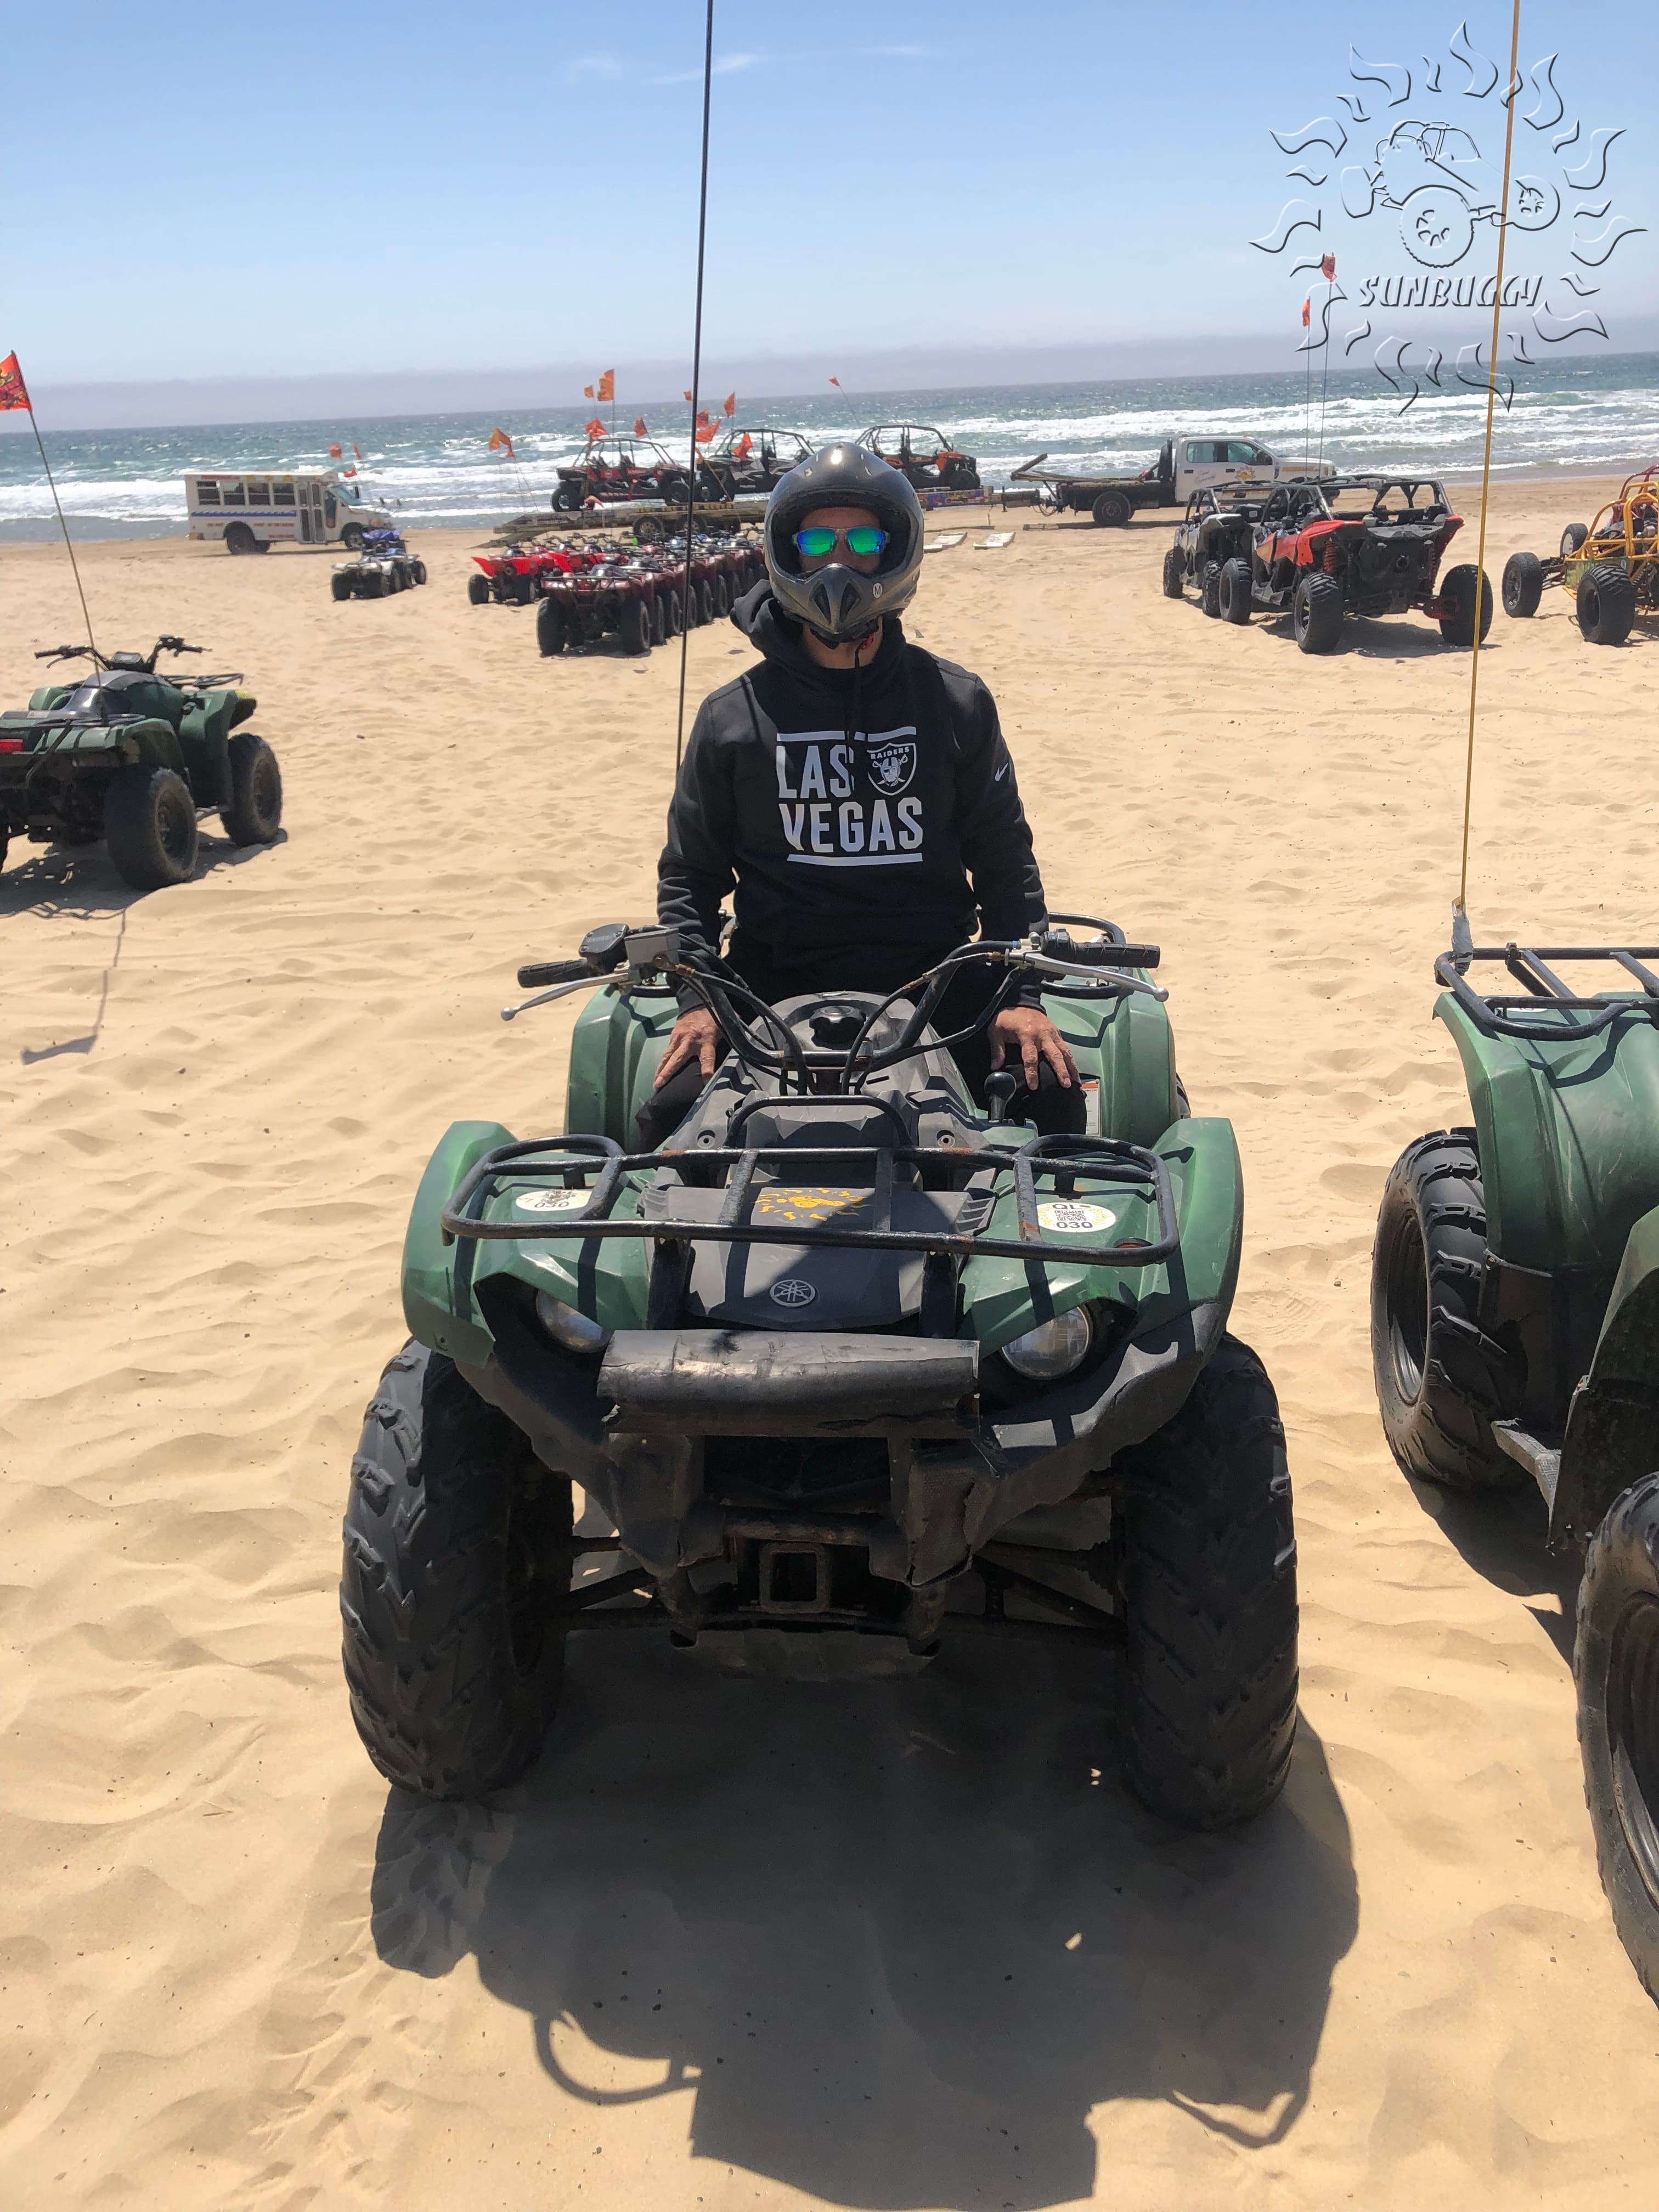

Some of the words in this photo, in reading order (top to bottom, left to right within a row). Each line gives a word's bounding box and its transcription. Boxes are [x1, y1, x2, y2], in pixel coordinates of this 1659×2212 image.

[874, 585, 881, 595] M
[870, 747, 910, 759] RAIDERS
[776, 744, 854, 799] LAS
[778, 797, 923, 853] VEGAS
